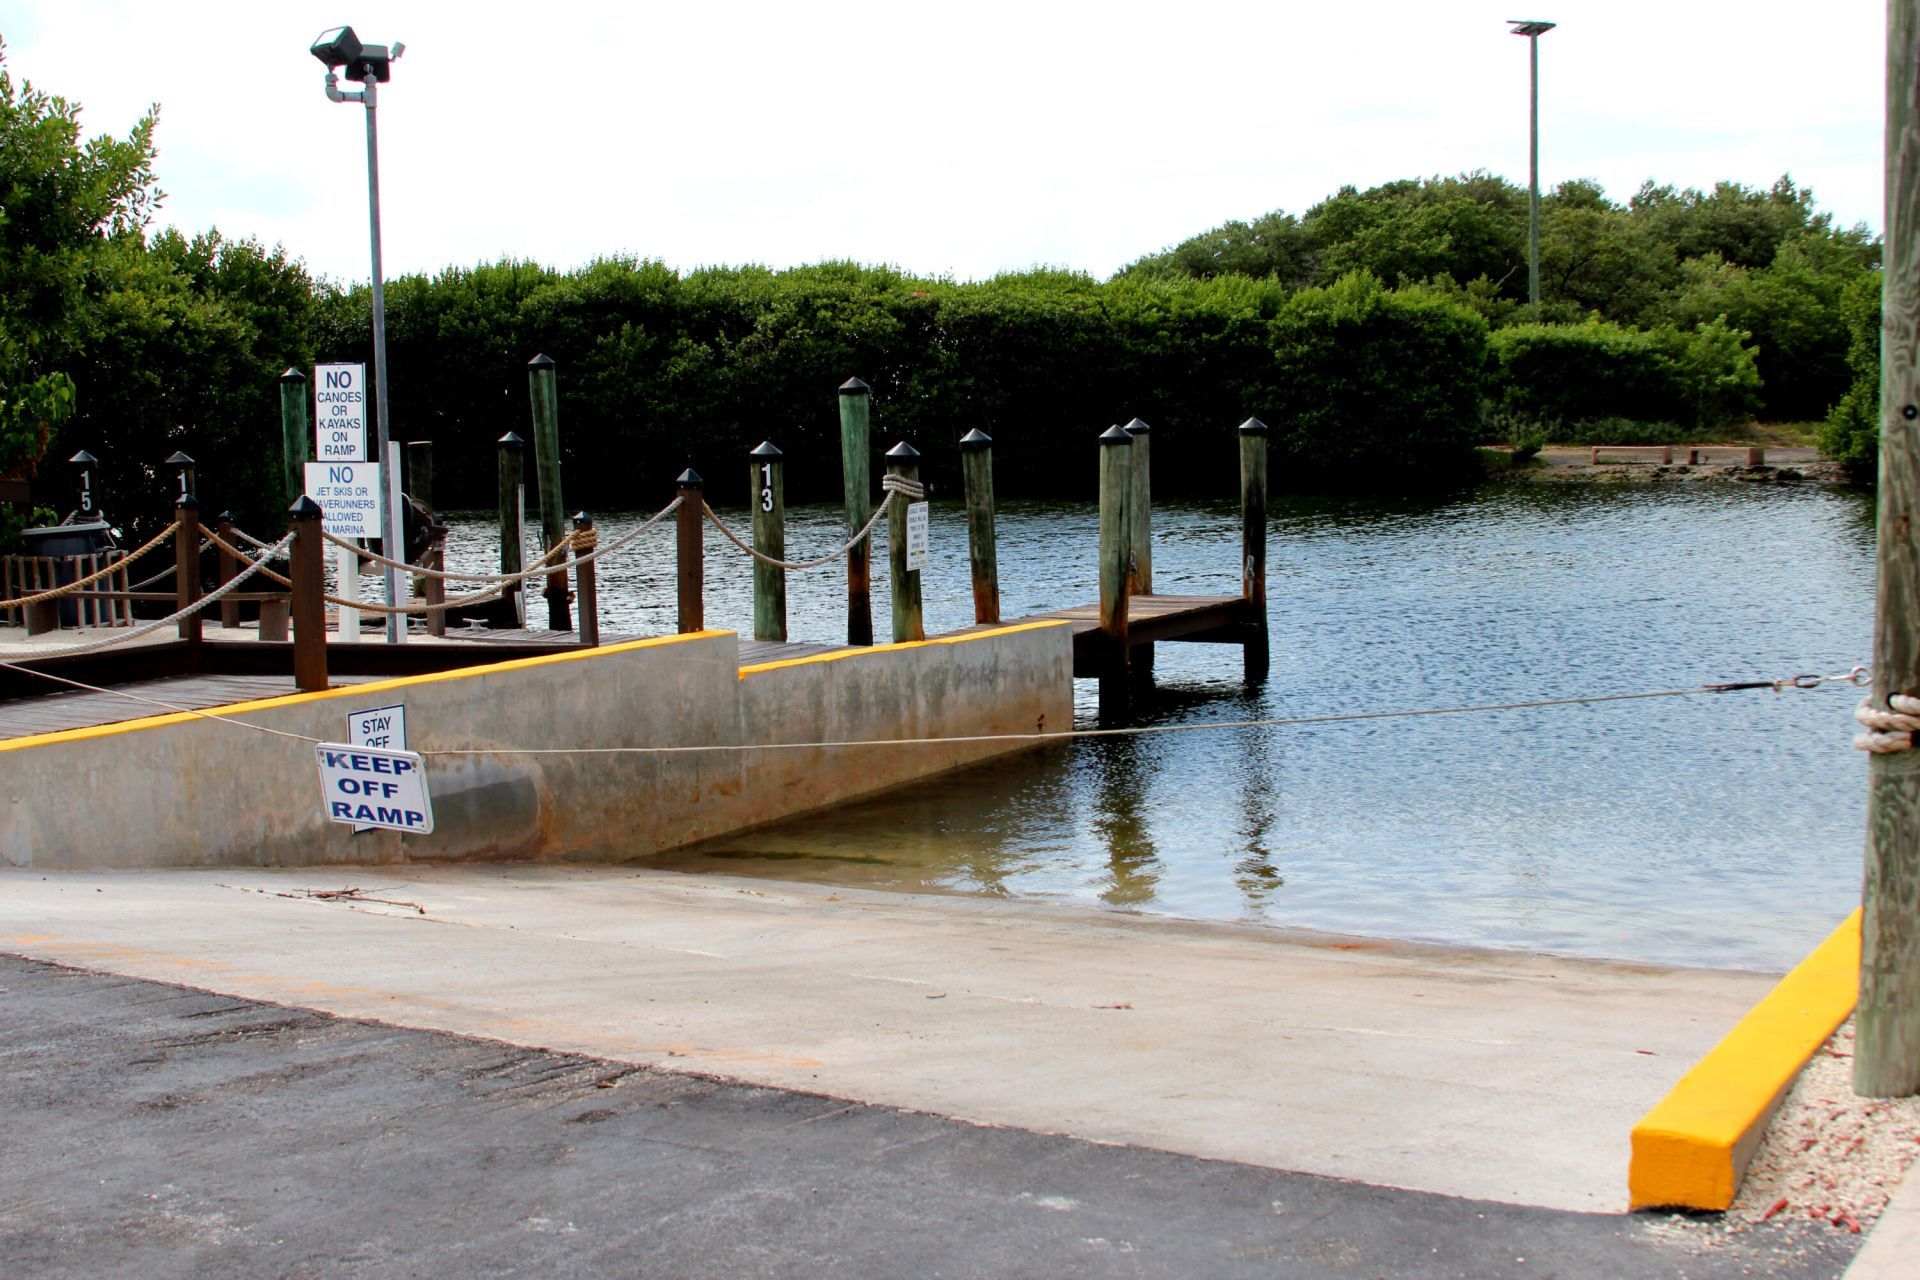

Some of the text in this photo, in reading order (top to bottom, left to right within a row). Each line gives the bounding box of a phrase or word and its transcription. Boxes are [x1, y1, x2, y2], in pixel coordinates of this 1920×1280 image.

[326, 371, 352, 389] NO
[317, 392, 362, 403] CANOES
[332, 405, 348, 416] OR
[319, 418, 361, 429] KAYAKS
[332, 431, 348, 442] ON
[324, 445, 356, 456] RAMP
[329, 466, 354, 484] NO
[316, 487, 369, 496] JET SKIS OR
[322, 512, 364, 522] ALLOWED
[332, 525, 365, 534] MARINA
[362, 716, 392, 734] STAY
[325, 752, 413, 776] KEEP
[337, 778, 399, 799] OFF
[331, 801, 424, 827] RAMP
